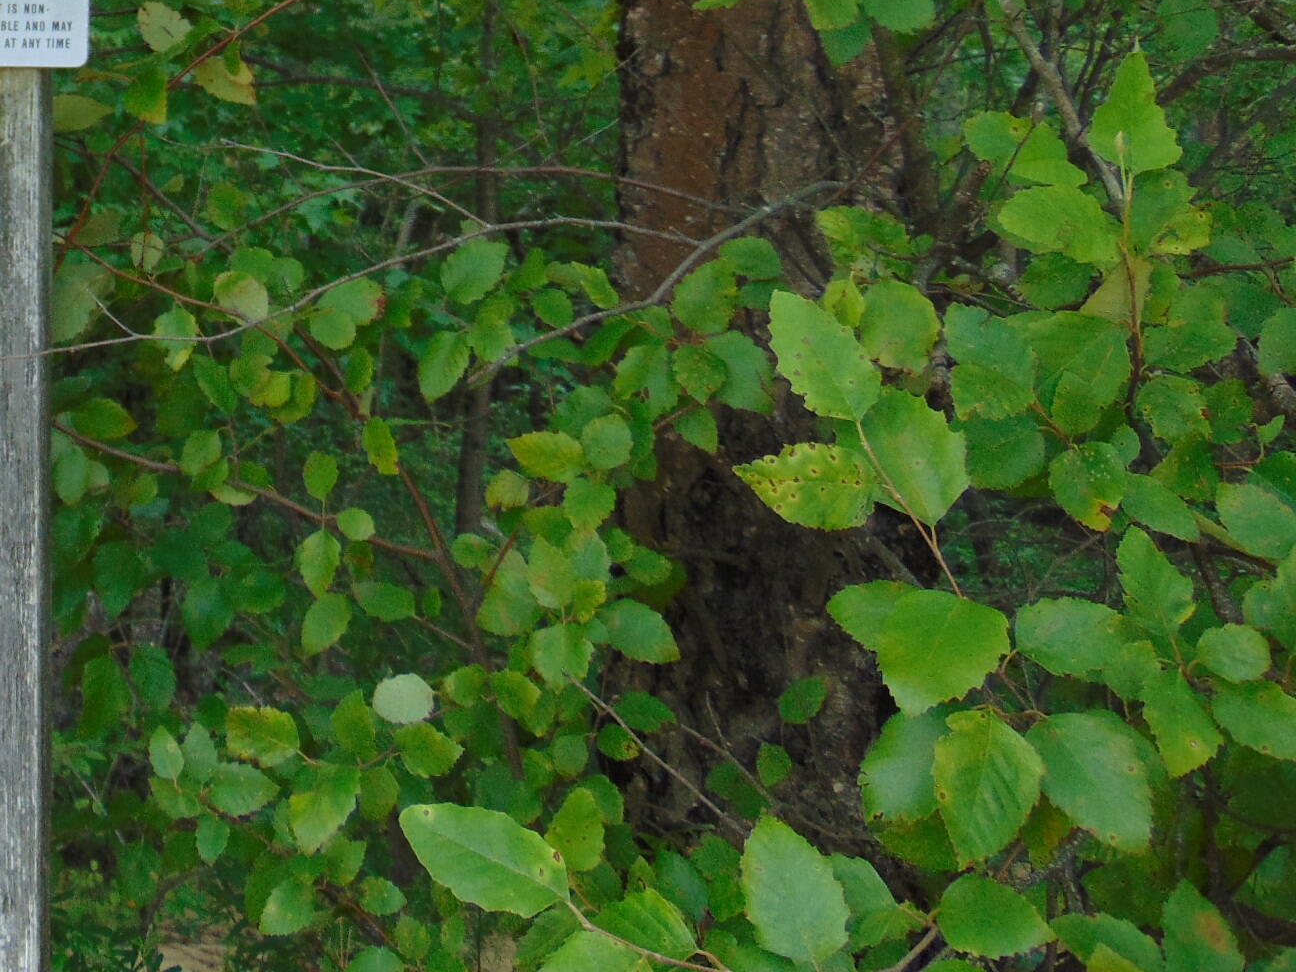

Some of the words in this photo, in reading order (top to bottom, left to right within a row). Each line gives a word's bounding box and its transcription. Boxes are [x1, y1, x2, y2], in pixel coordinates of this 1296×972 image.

[7, 3, 18, 14] IS
[23, 3, 51, 14] NON-
[25, 21, 46, 32] AND
[51, 21, 73, 32] MAY
[4, 38, 16, 49] AT
[21, 38, 41, 49] ANY
[46, 38, 71, 49] TIME
